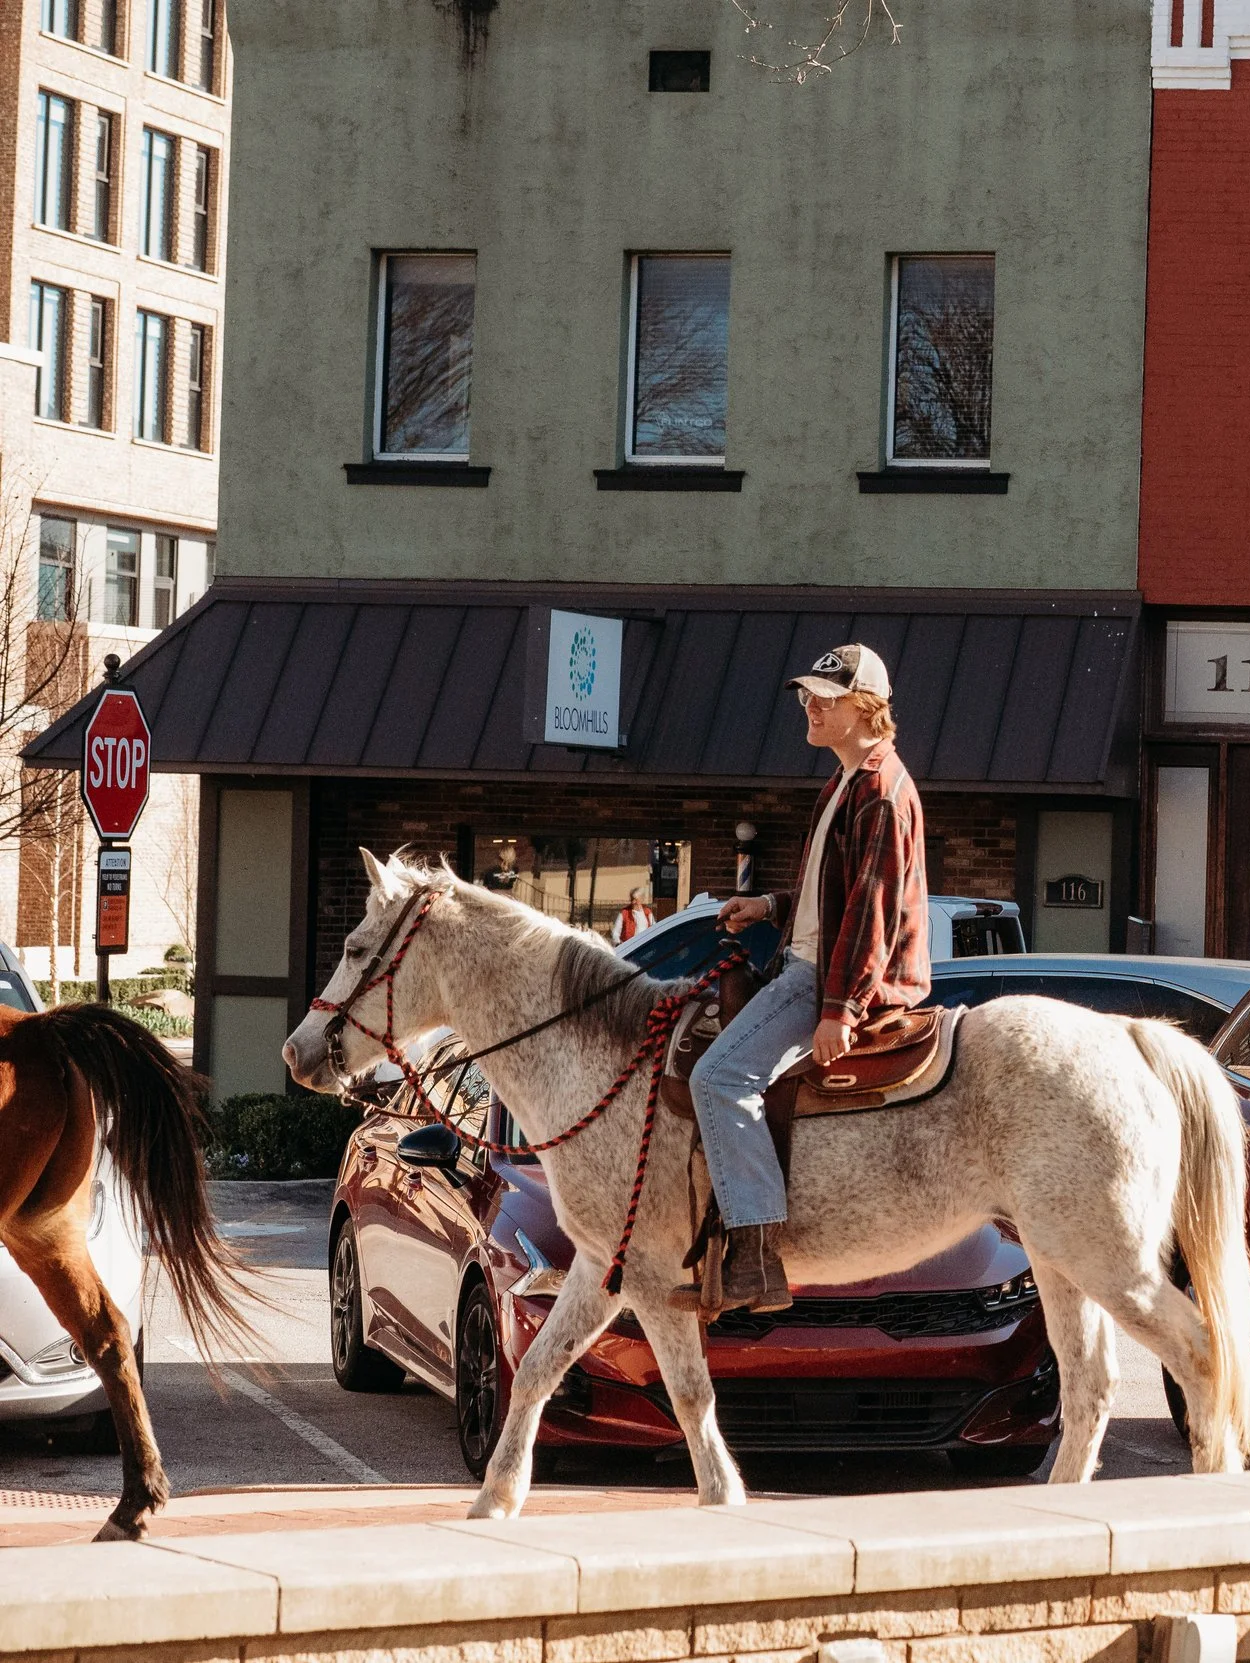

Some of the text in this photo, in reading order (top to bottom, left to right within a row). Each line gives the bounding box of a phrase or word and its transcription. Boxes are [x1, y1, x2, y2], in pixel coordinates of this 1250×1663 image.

[554, 706, 609, 735] BLOOMHILLS
[90, 736, 146, 789] STOP
[1061, 882, 1086, 901] 116
